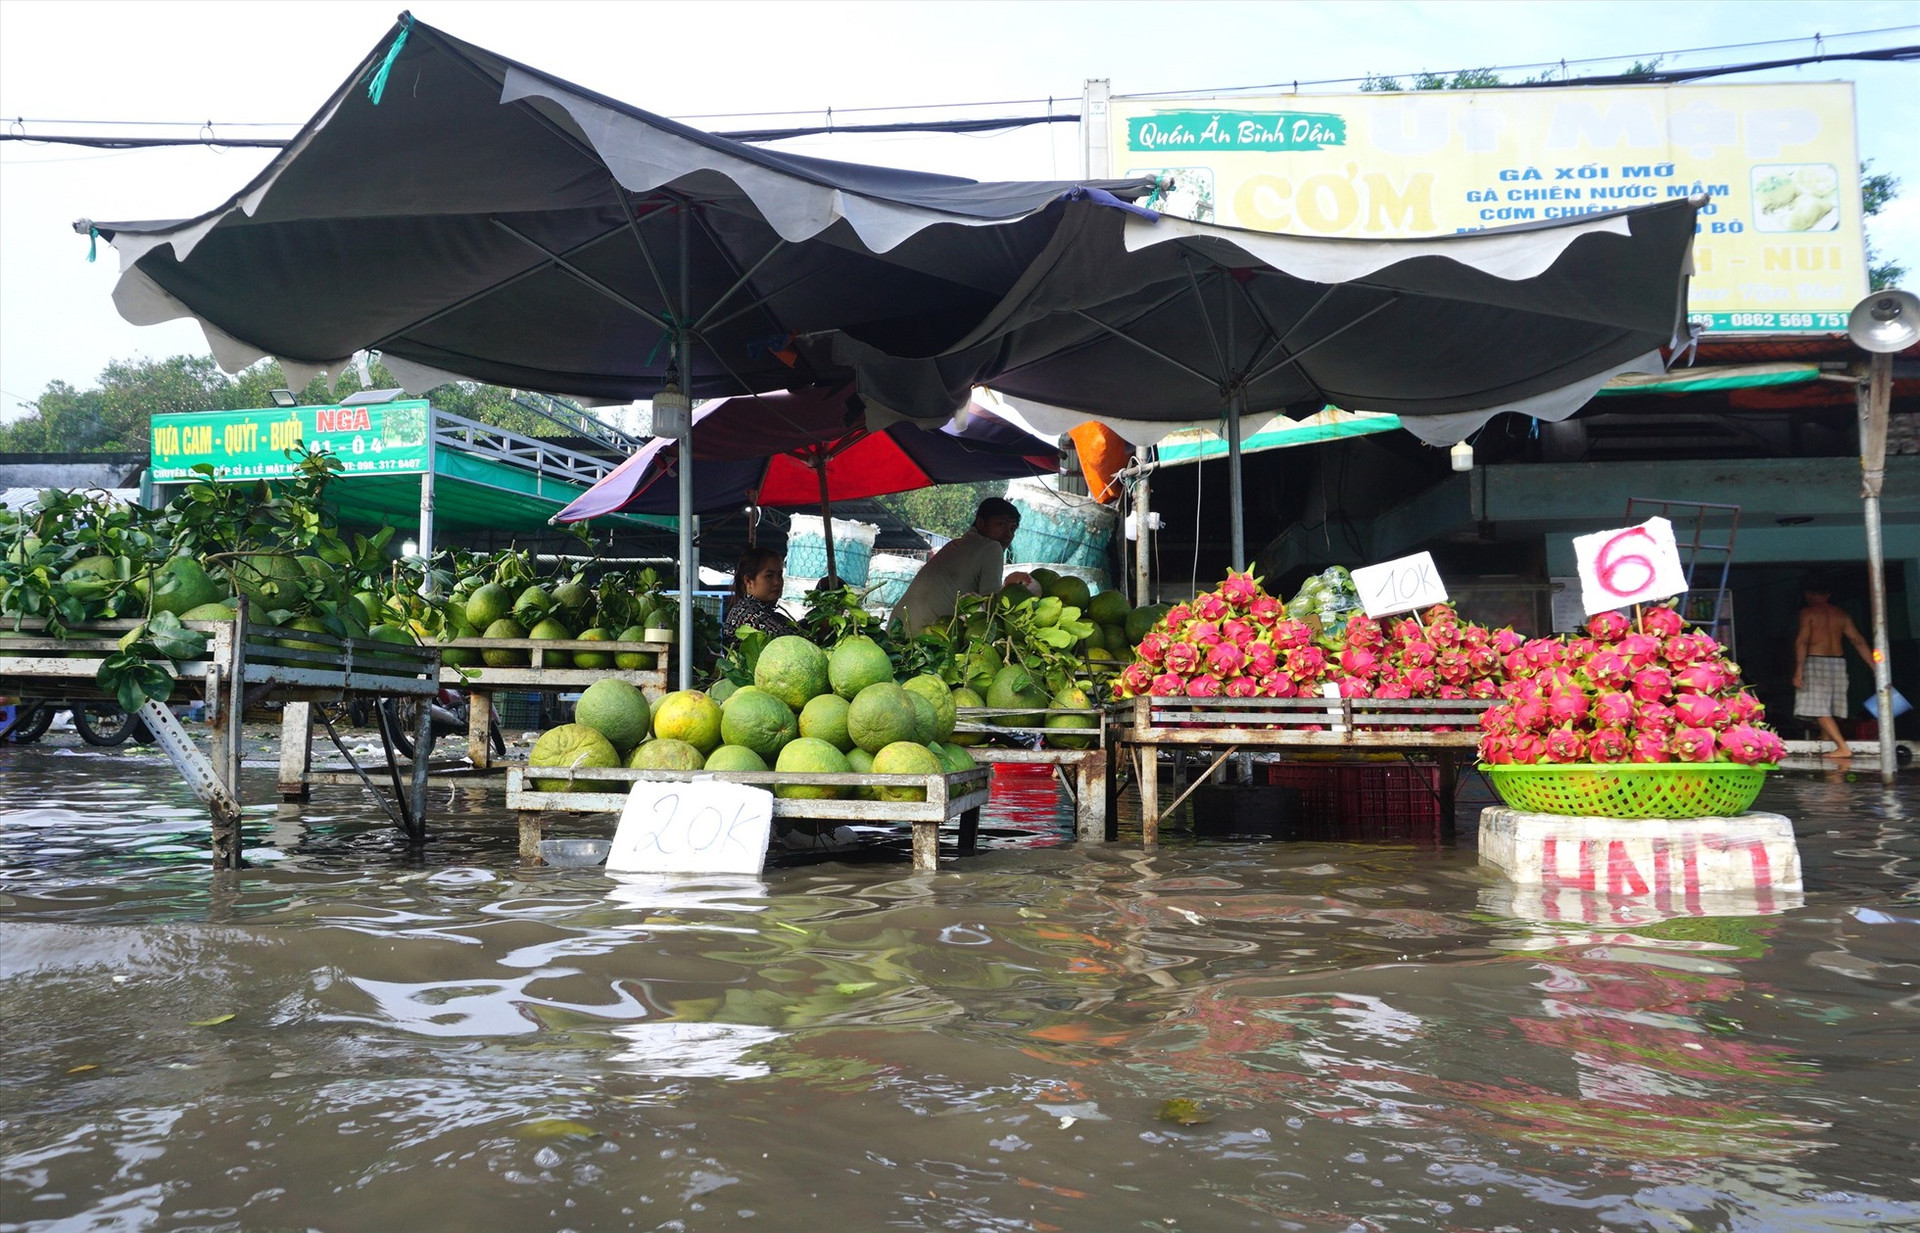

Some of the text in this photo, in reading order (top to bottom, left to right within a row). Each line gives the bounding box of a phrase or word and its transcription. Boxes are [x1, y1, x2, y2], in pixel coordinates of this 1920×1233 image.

[1139, 115, 1336, 146] Quán Ăn Bình Dân
[1499, 165, 1543, 182] GÀ
[1555, 162, 1609, 179] XỐI
[1233, 161, 1438, 232] CƠM
[1466, 188, 1499, 203] GÀ
[1507, 185, 1581, 201] CHIÊN
[1590, 184, 1657, 199] NƯỚC
[1479, 206, 1535, 221] CƠM
[1764, 246, 1841, 271] NUI
[1688, 313, 1714, 328] 86
[1731, 313, 1776, 328] 0862
[1779, 313, 1813, 328] 569
[1816, 312, 1849, 327] 751
[316, 407, 372, 433] NGA
[154, 425, 180, 463] VỰA
[182, 425, 213, 455] CAM
[224, 417, 259, 456] QUÝT
[352, 435, 365, 455] Ô
[370, 438, 382, 453] 4
[1595, 526, 1657, 598] 6
[1375, 563, 1438, 602] 10K
[632, 793, 761, 855] 20K
